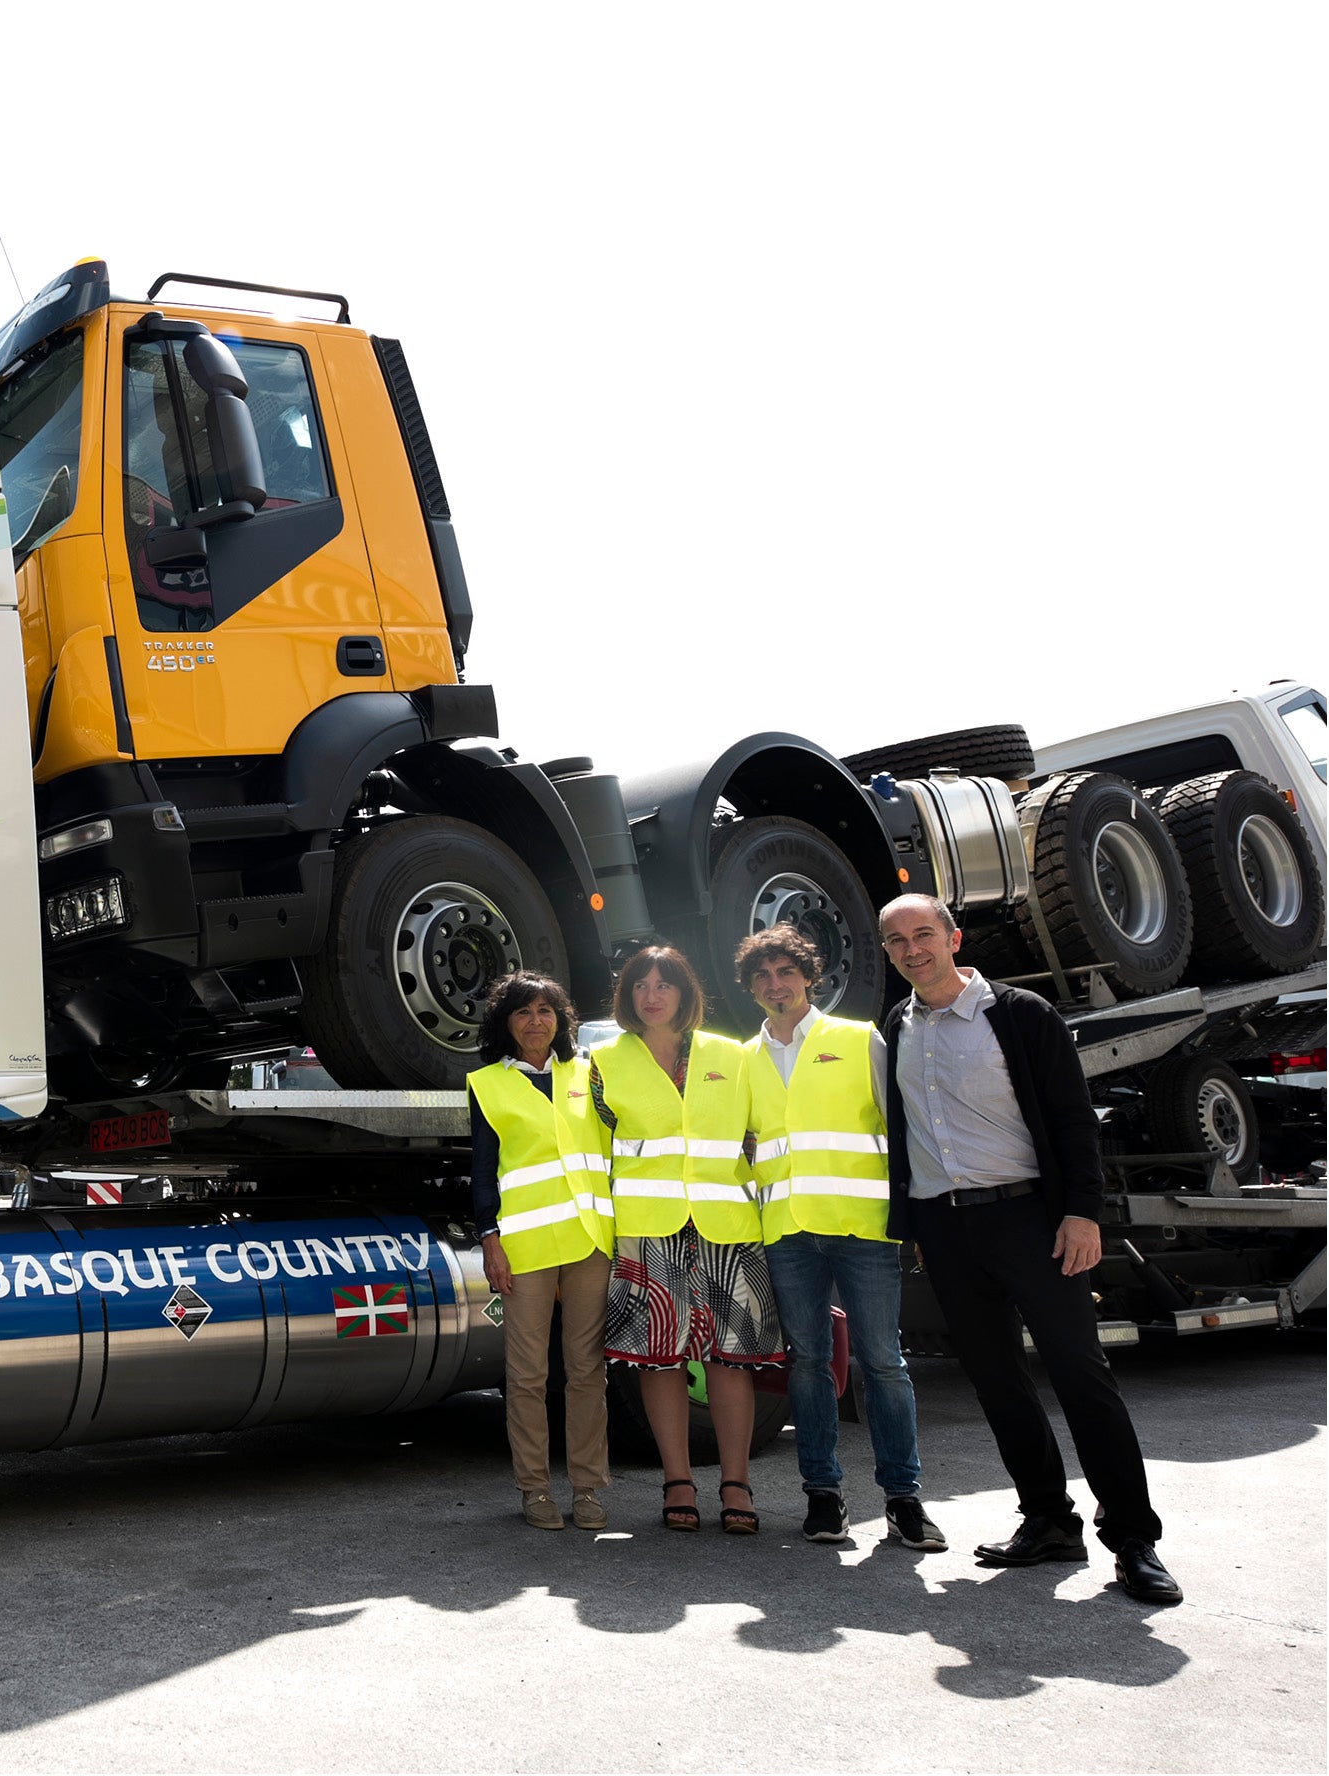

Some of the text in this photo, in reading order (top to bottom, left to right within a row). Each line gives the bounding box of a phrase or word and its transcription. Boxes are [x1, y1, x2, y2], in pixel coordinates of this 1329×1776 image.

[144, 641, 215, 651] TRAKKER
[147, 655, 196, 672] 450
[1135, 889, 1188, 974] CONTINENTAL
[206, 1232, 429, 1283] COUNTRY
